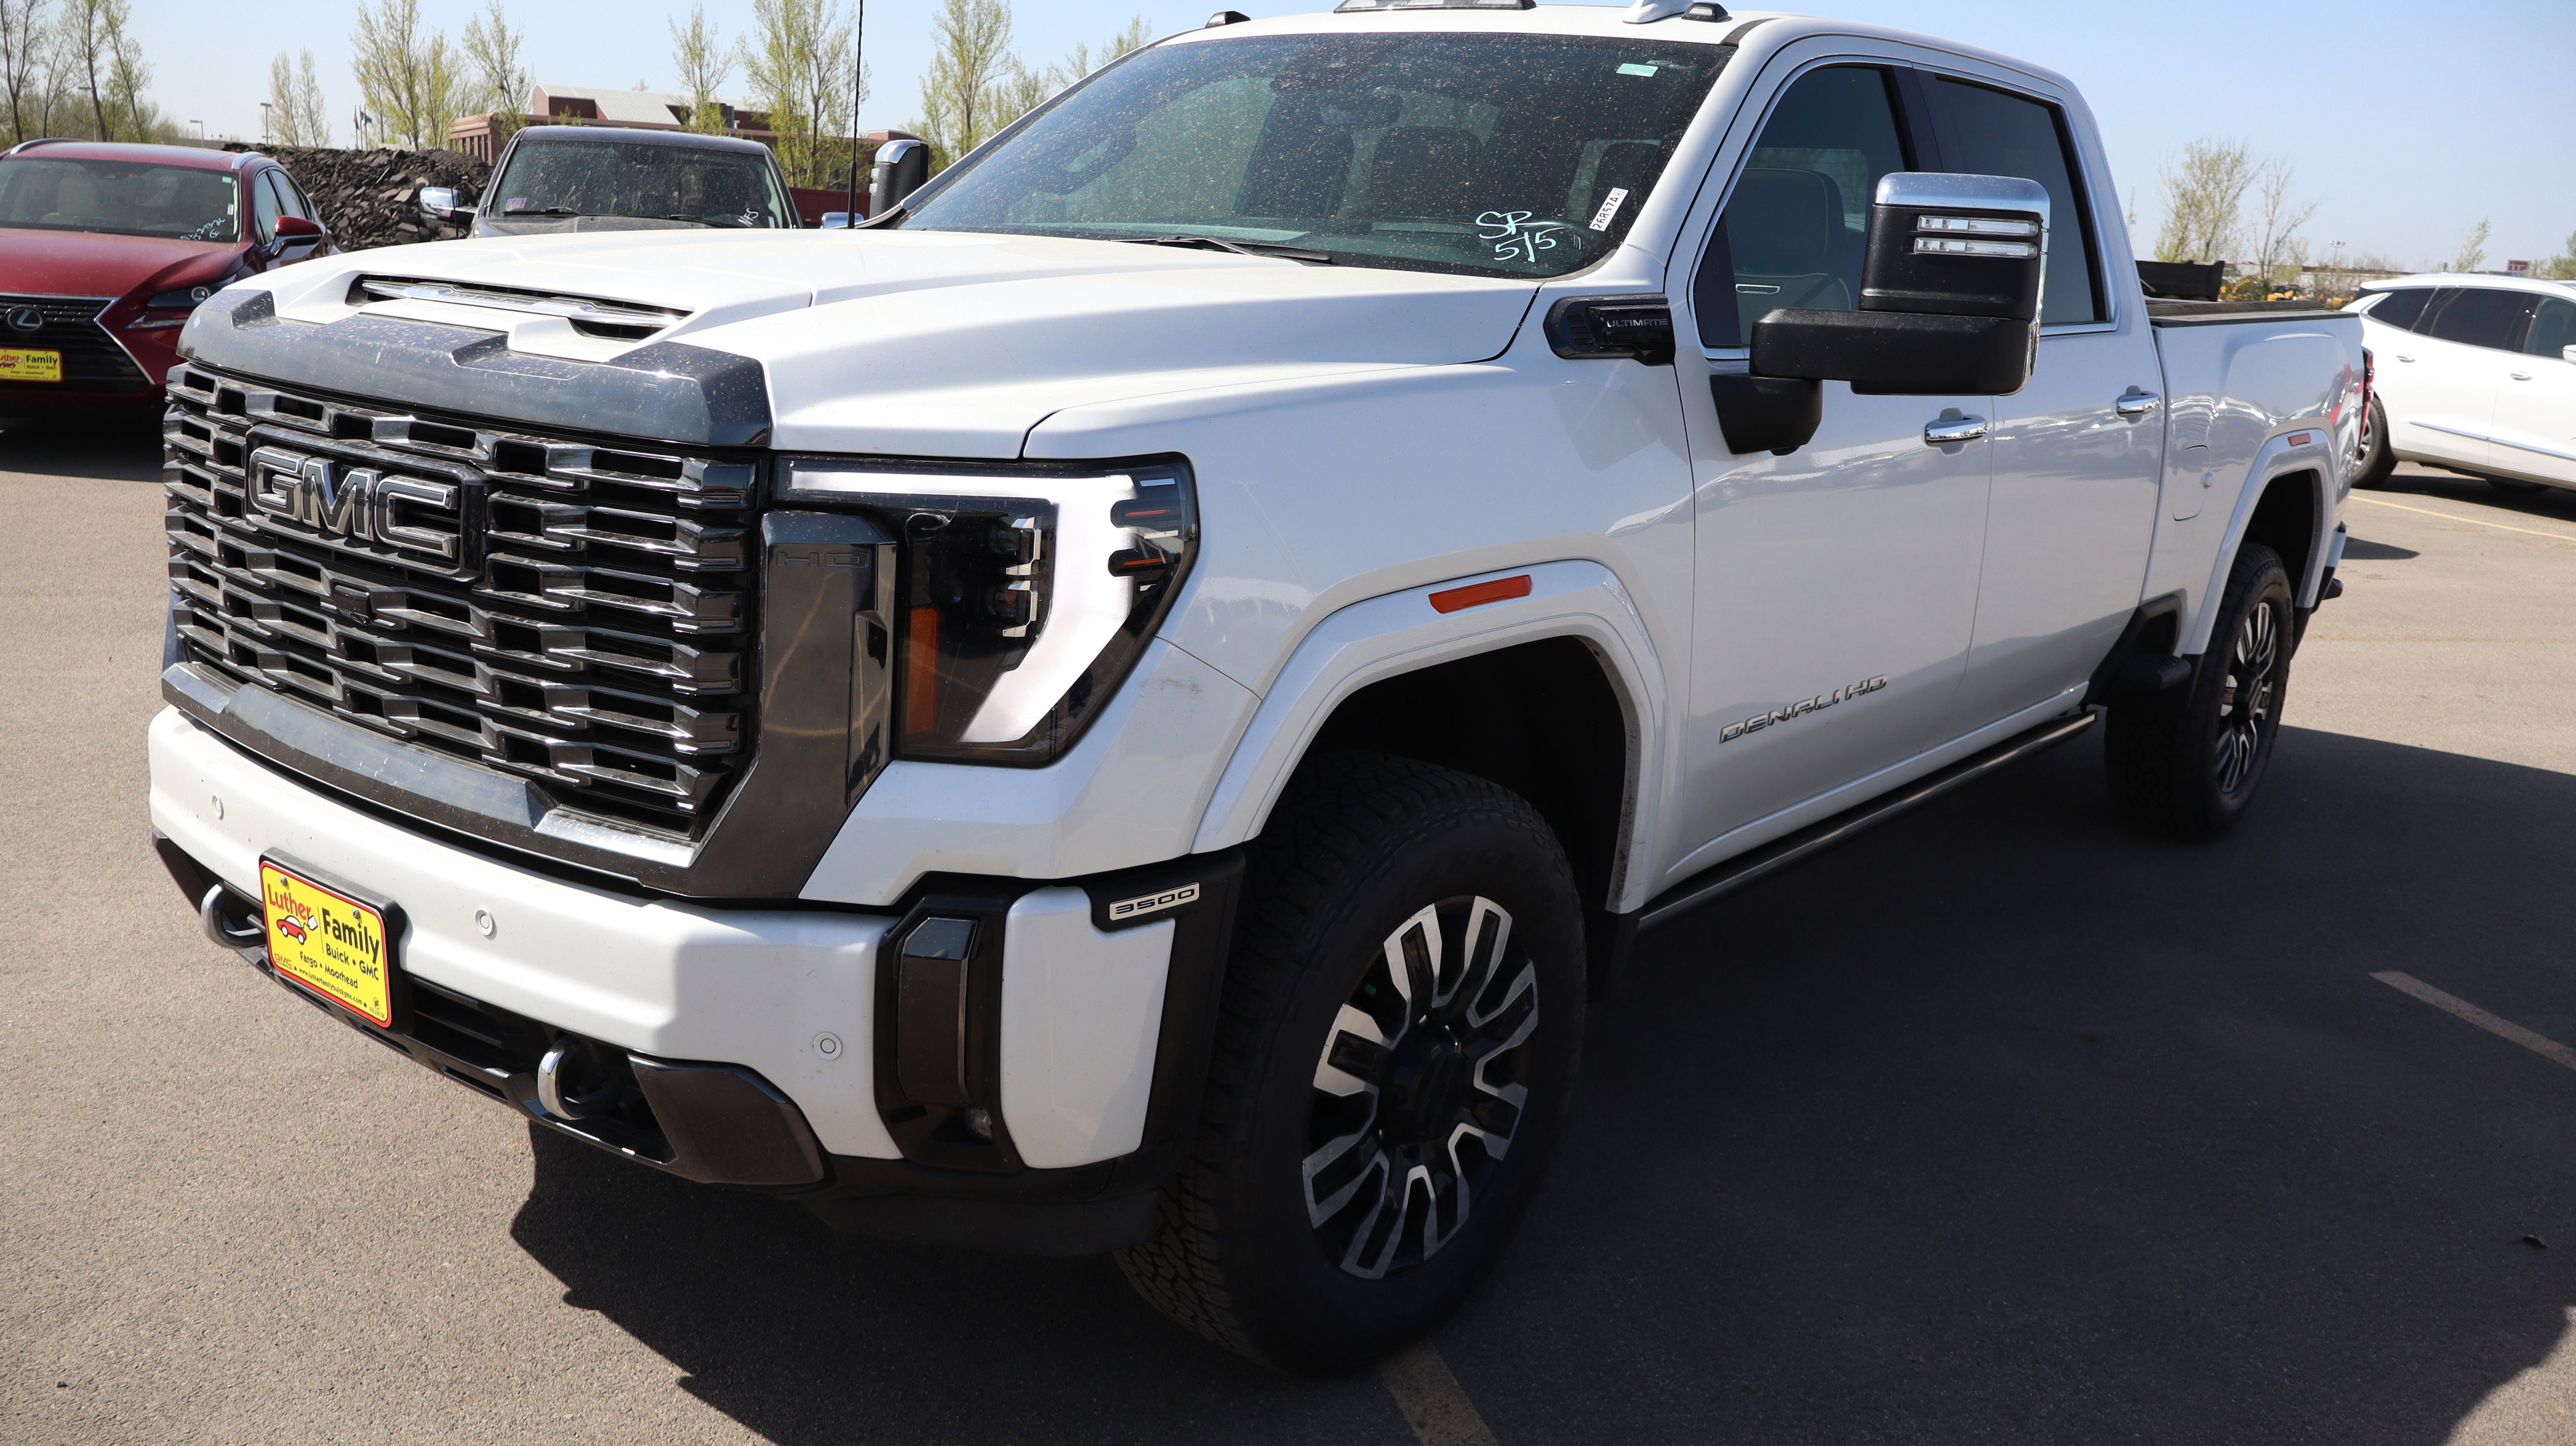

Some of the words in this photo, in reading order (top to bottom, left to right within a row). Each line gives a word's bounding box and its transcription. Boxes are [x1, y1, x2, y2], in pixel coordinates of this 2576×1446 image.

[1593, 197, 1618, 229] 26857A
[1606, 318, 1668, 327] ULTIMATE
[26, 355, 58, 365] Family
[248, 446, 458, 559] GMC
[777, 551, 868, 568] HD
[1719, 689, 1841, 744] DENALI
[1845, 674, 1888, 700] HD
[267, 884, 310, 920] Luther
[1115, 889, 1195, 914] 3500
[322, 907, 380, 964] Family
[275, 953, 292, 967] GMC
[300, 951, 318, 968] Fargo
[325, 964, 358, 989] Moorhead
[326, 943, 350, 966] Buick
[359, 960, 379, 981] GMC
[298, 967, 362, 1005] www.lutherfamilybuickgmc.com
[369, 1006, 385, 1019] BUICK
